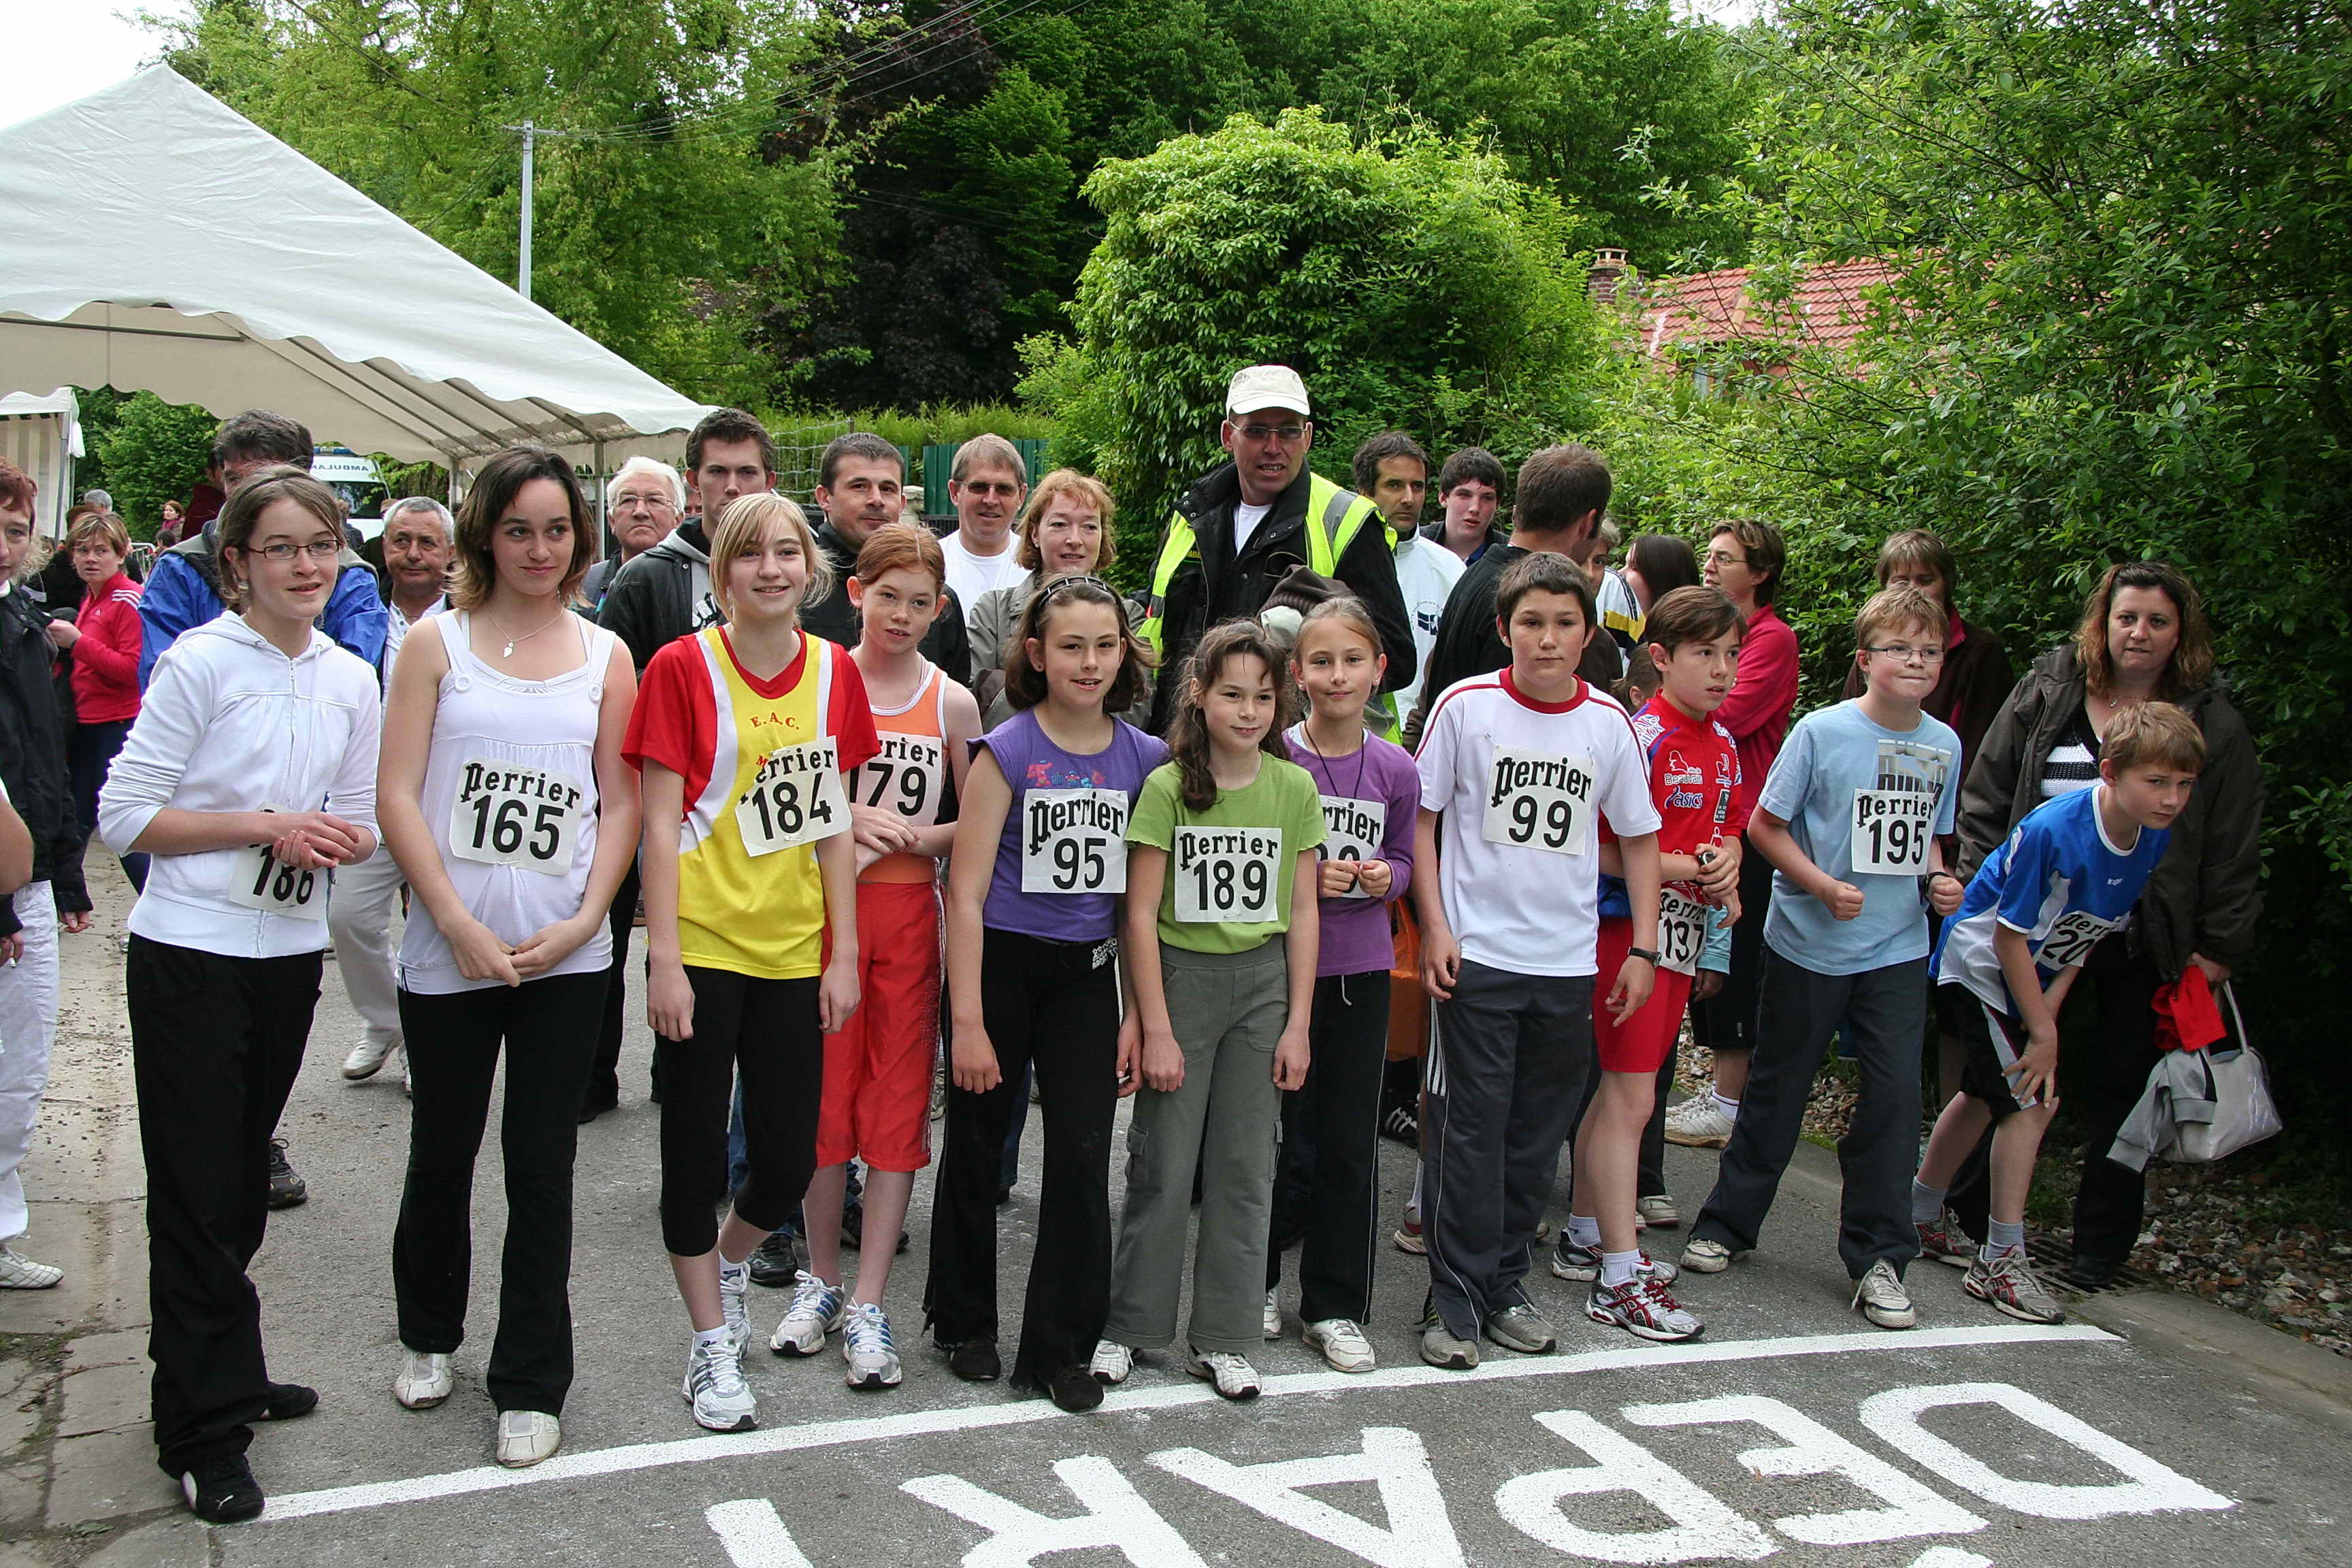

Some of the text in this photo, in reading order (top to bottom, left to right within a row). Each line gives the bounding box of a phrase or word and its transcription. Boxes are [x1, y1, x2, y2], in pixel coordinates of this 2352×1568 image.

[750, 712, 800, 730] E.A.C.
[879, 736, 938, 768] rier
[460, 762, 581, 810] perrier
[751, 771, 832, 841] 184
[1490, 756, 1592, 808] perrier
[472, 794, 565, 861] 165
[1028, 791, 1124, 857] perrier
[1508, 794, 1573, 849] 99
[1857, 794, 1933, 828] perrier
[1052, 837, 1107, 890] 95
[1179, 830, 1278, 872] perrier
[1868, 819, 1927, 865] 195
[1193, 859, 1268, 911] 189
[1663, 915, 1705, 964] 197
[2042, 929, 2095, 965] 20
